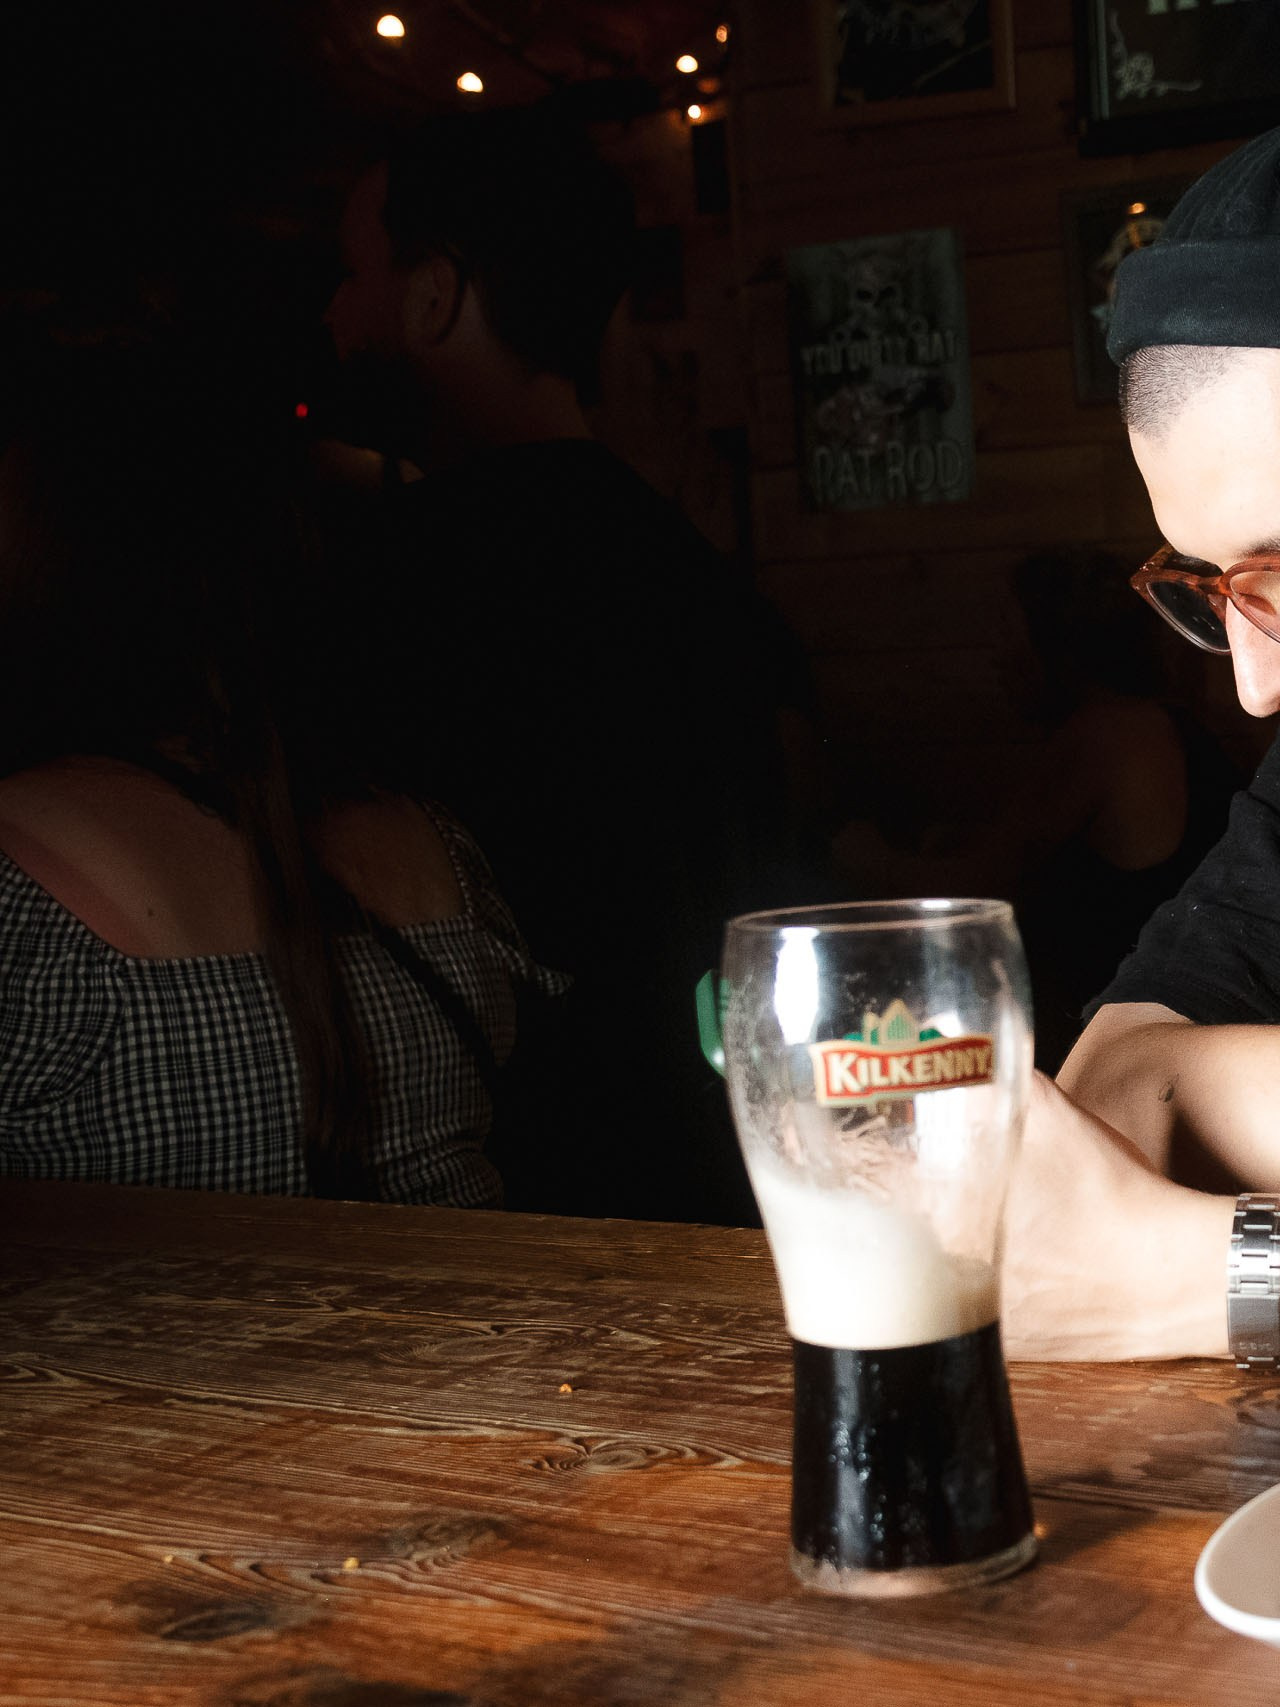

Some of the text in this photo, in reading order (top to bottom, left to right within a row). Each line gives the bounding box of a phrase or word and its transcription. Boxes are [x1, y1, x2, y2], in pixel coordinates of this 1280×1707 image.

[813, 438, 965, 501] RAT ROD
[826, 1047, 992, 1094] KILKENNY
